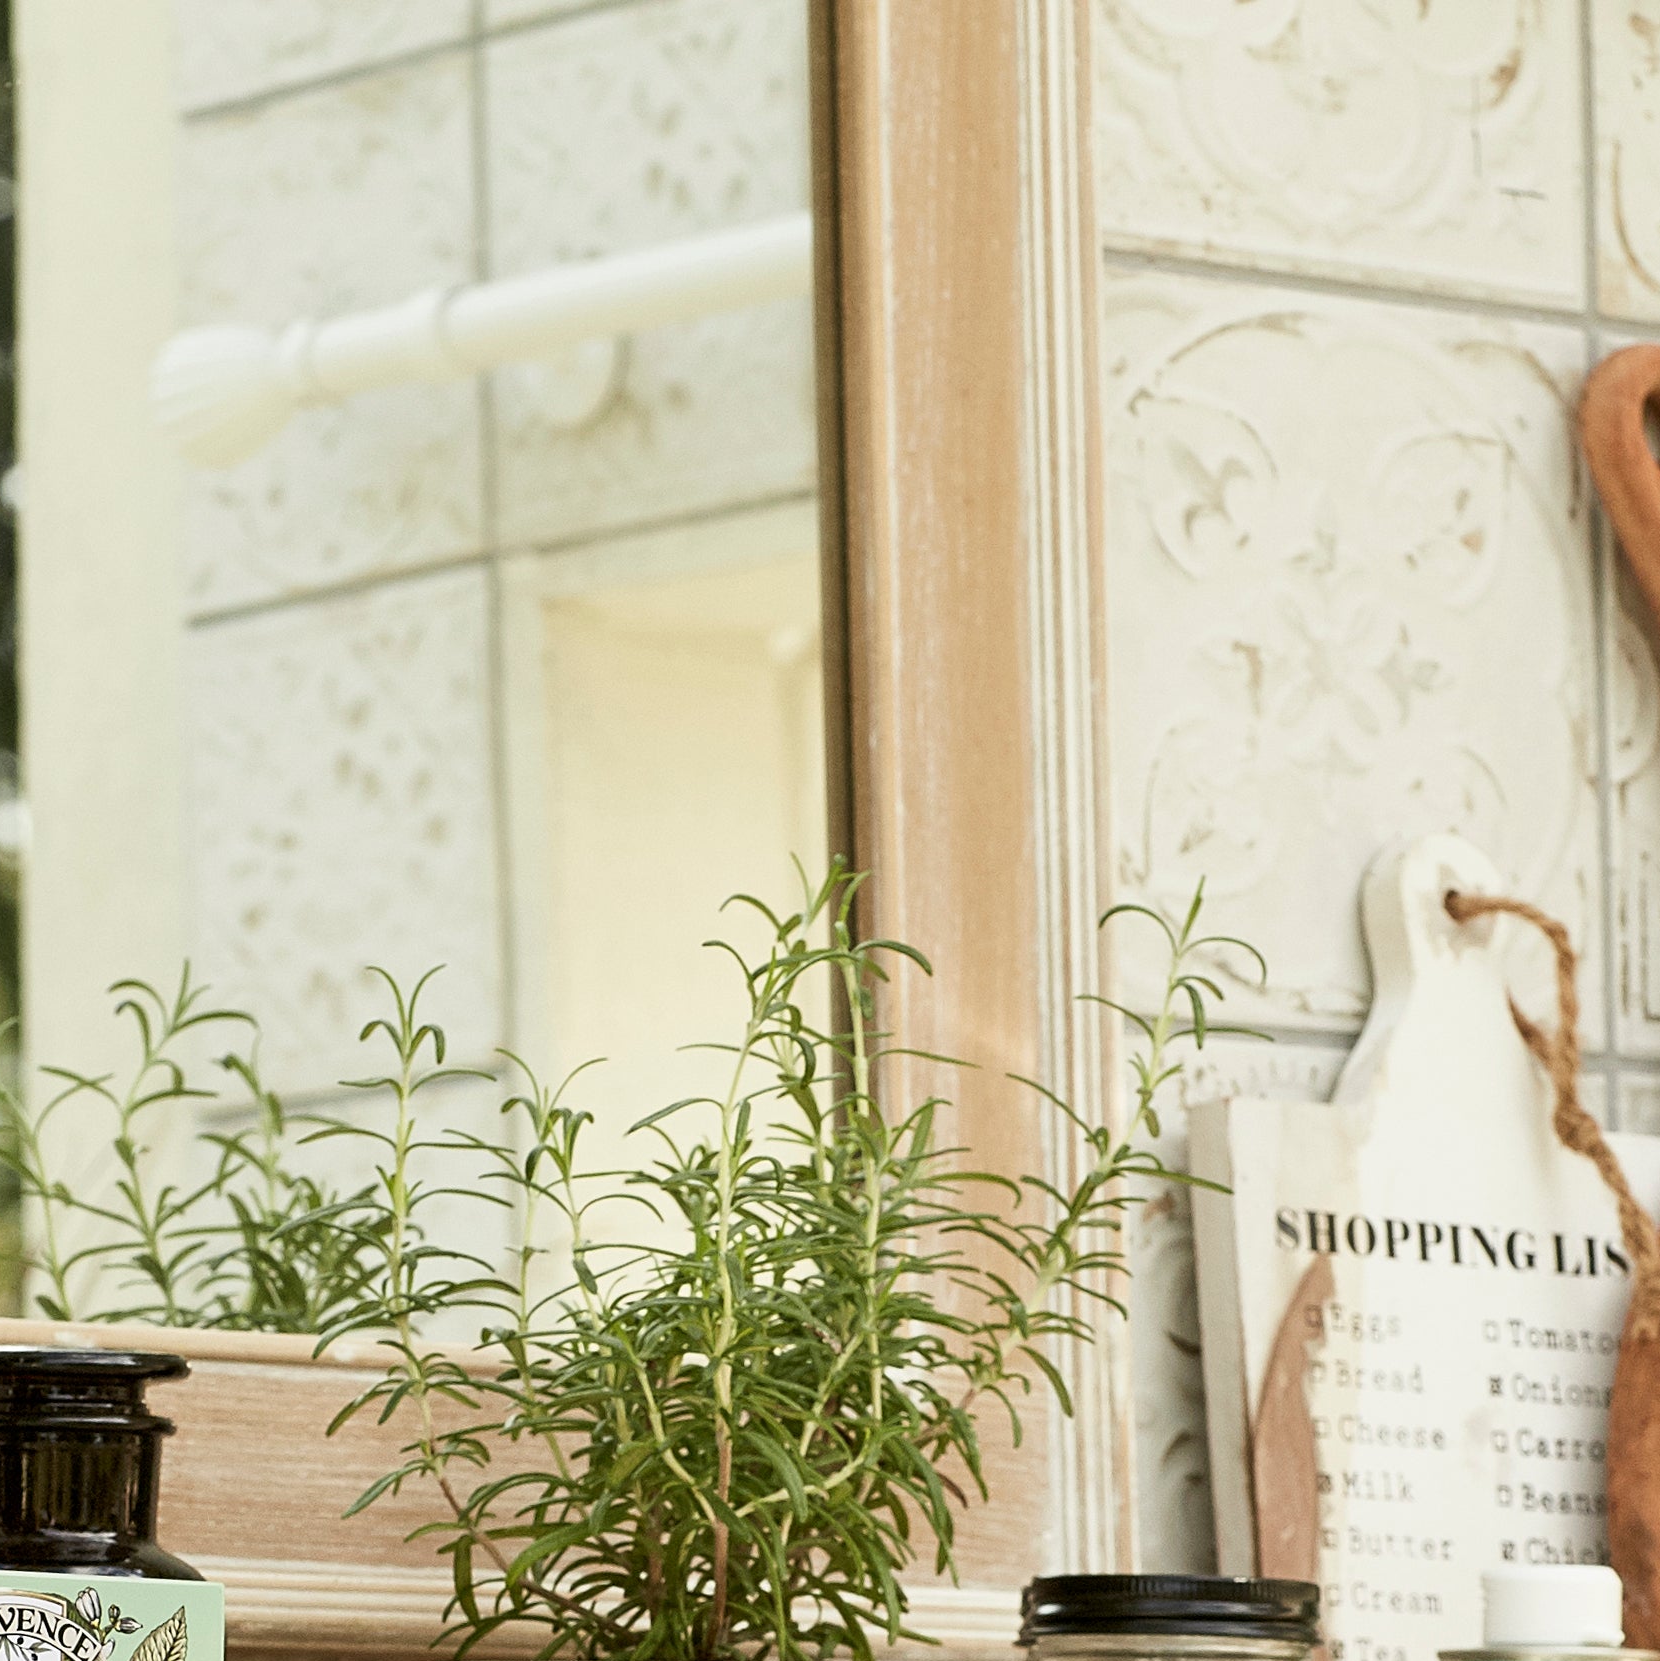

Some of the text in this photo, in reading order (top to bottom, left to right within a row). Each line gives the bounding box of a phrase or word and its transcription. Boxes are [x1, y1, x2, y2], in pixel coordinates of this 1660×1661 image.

[1275, 1207, 1634, 1279] SHOPPING LIS
[1330, 1303, 1402, 1344] Eggs
[1507, 1318, 1620, 1357] Tomato
[1335, 1360, 1425, 1395] Bread
[1337, 1413, 1447, 1450] Cheese
[1516, 1427, 1607, 1462] Carro
[1341, 1469, 1417, 1503] Milk
[1348, 1526, 1456, 1562] Butter
[1524, 1537, 1610, 1566] Chick
[1350, 1581, 1443, 1615] Cream
